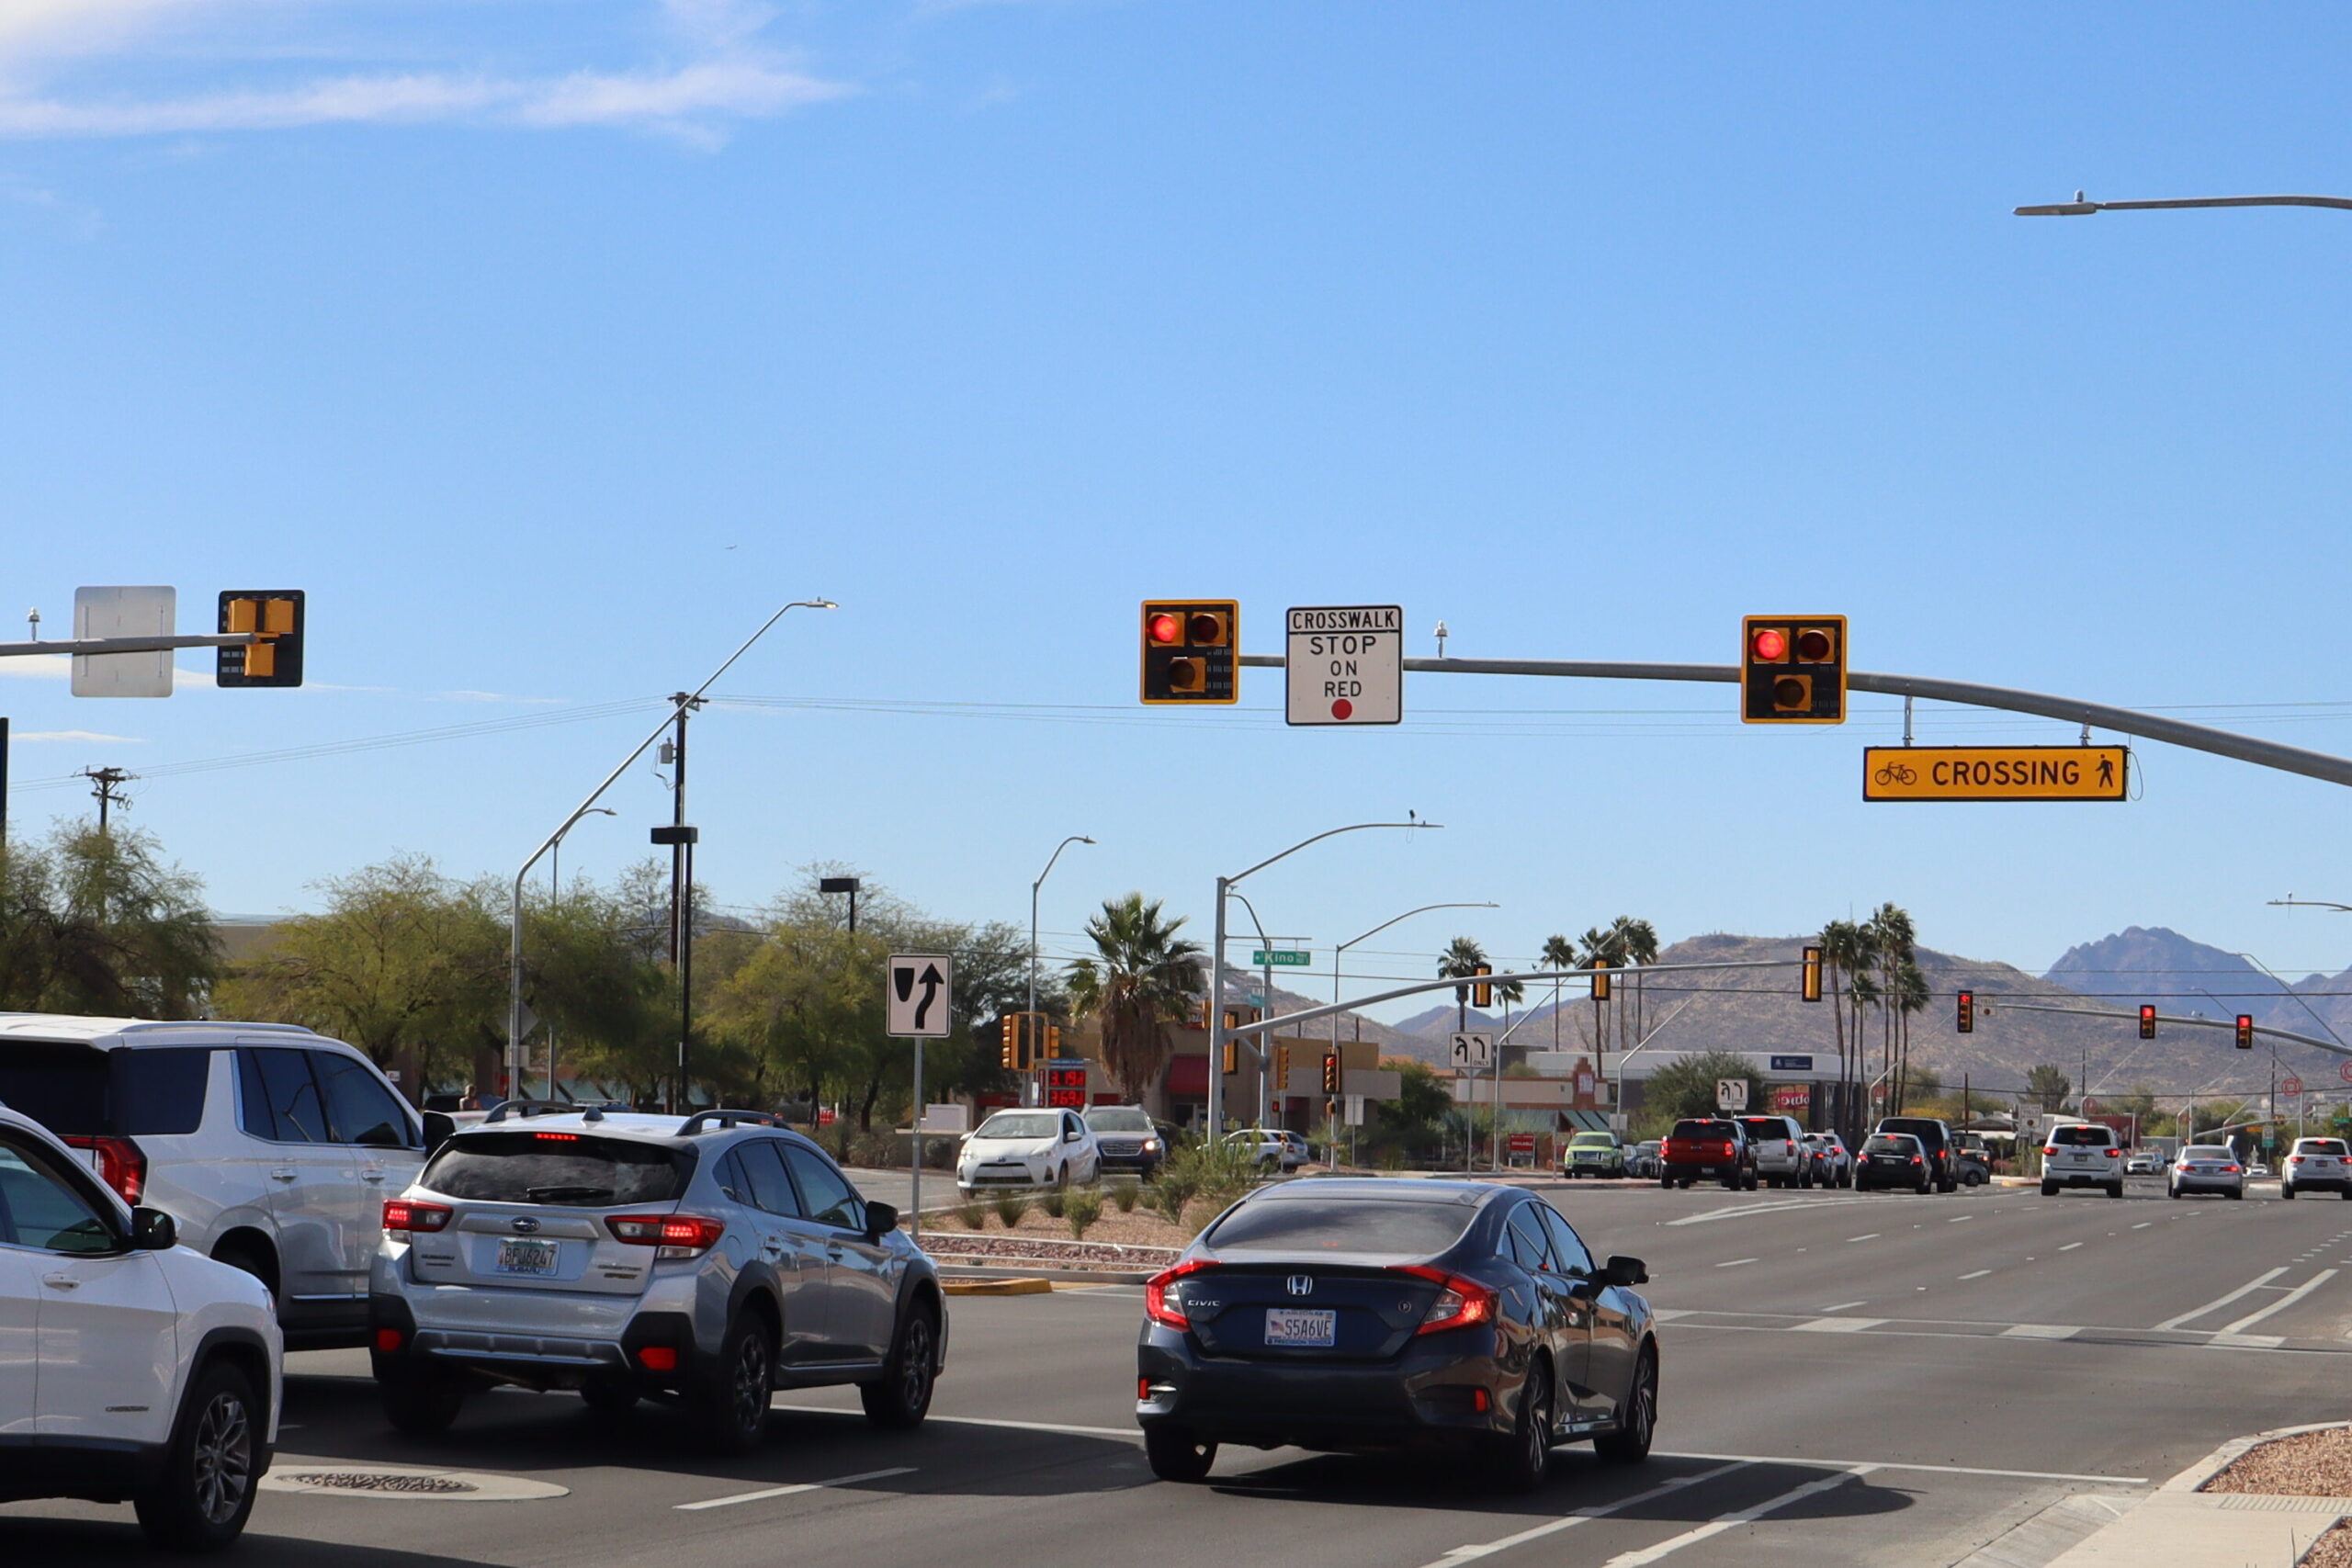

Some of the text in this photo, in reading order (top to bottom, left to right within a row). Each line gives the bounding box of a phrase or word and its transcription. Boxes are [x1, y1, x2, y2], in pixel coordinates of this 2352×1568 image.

[1293, 610, 1395, 629] CROSSWALK
[1309, 635, 1376, 655] STOP
[1329, 660, 1357, 677] ON
[1324, 681, 1362, 697] RED
[1931, 761, 2080, 785] CROSSING
[1264, 952, 1295, 964] Kino
[1284, 1319, 1331, 1337] S5A6VE
